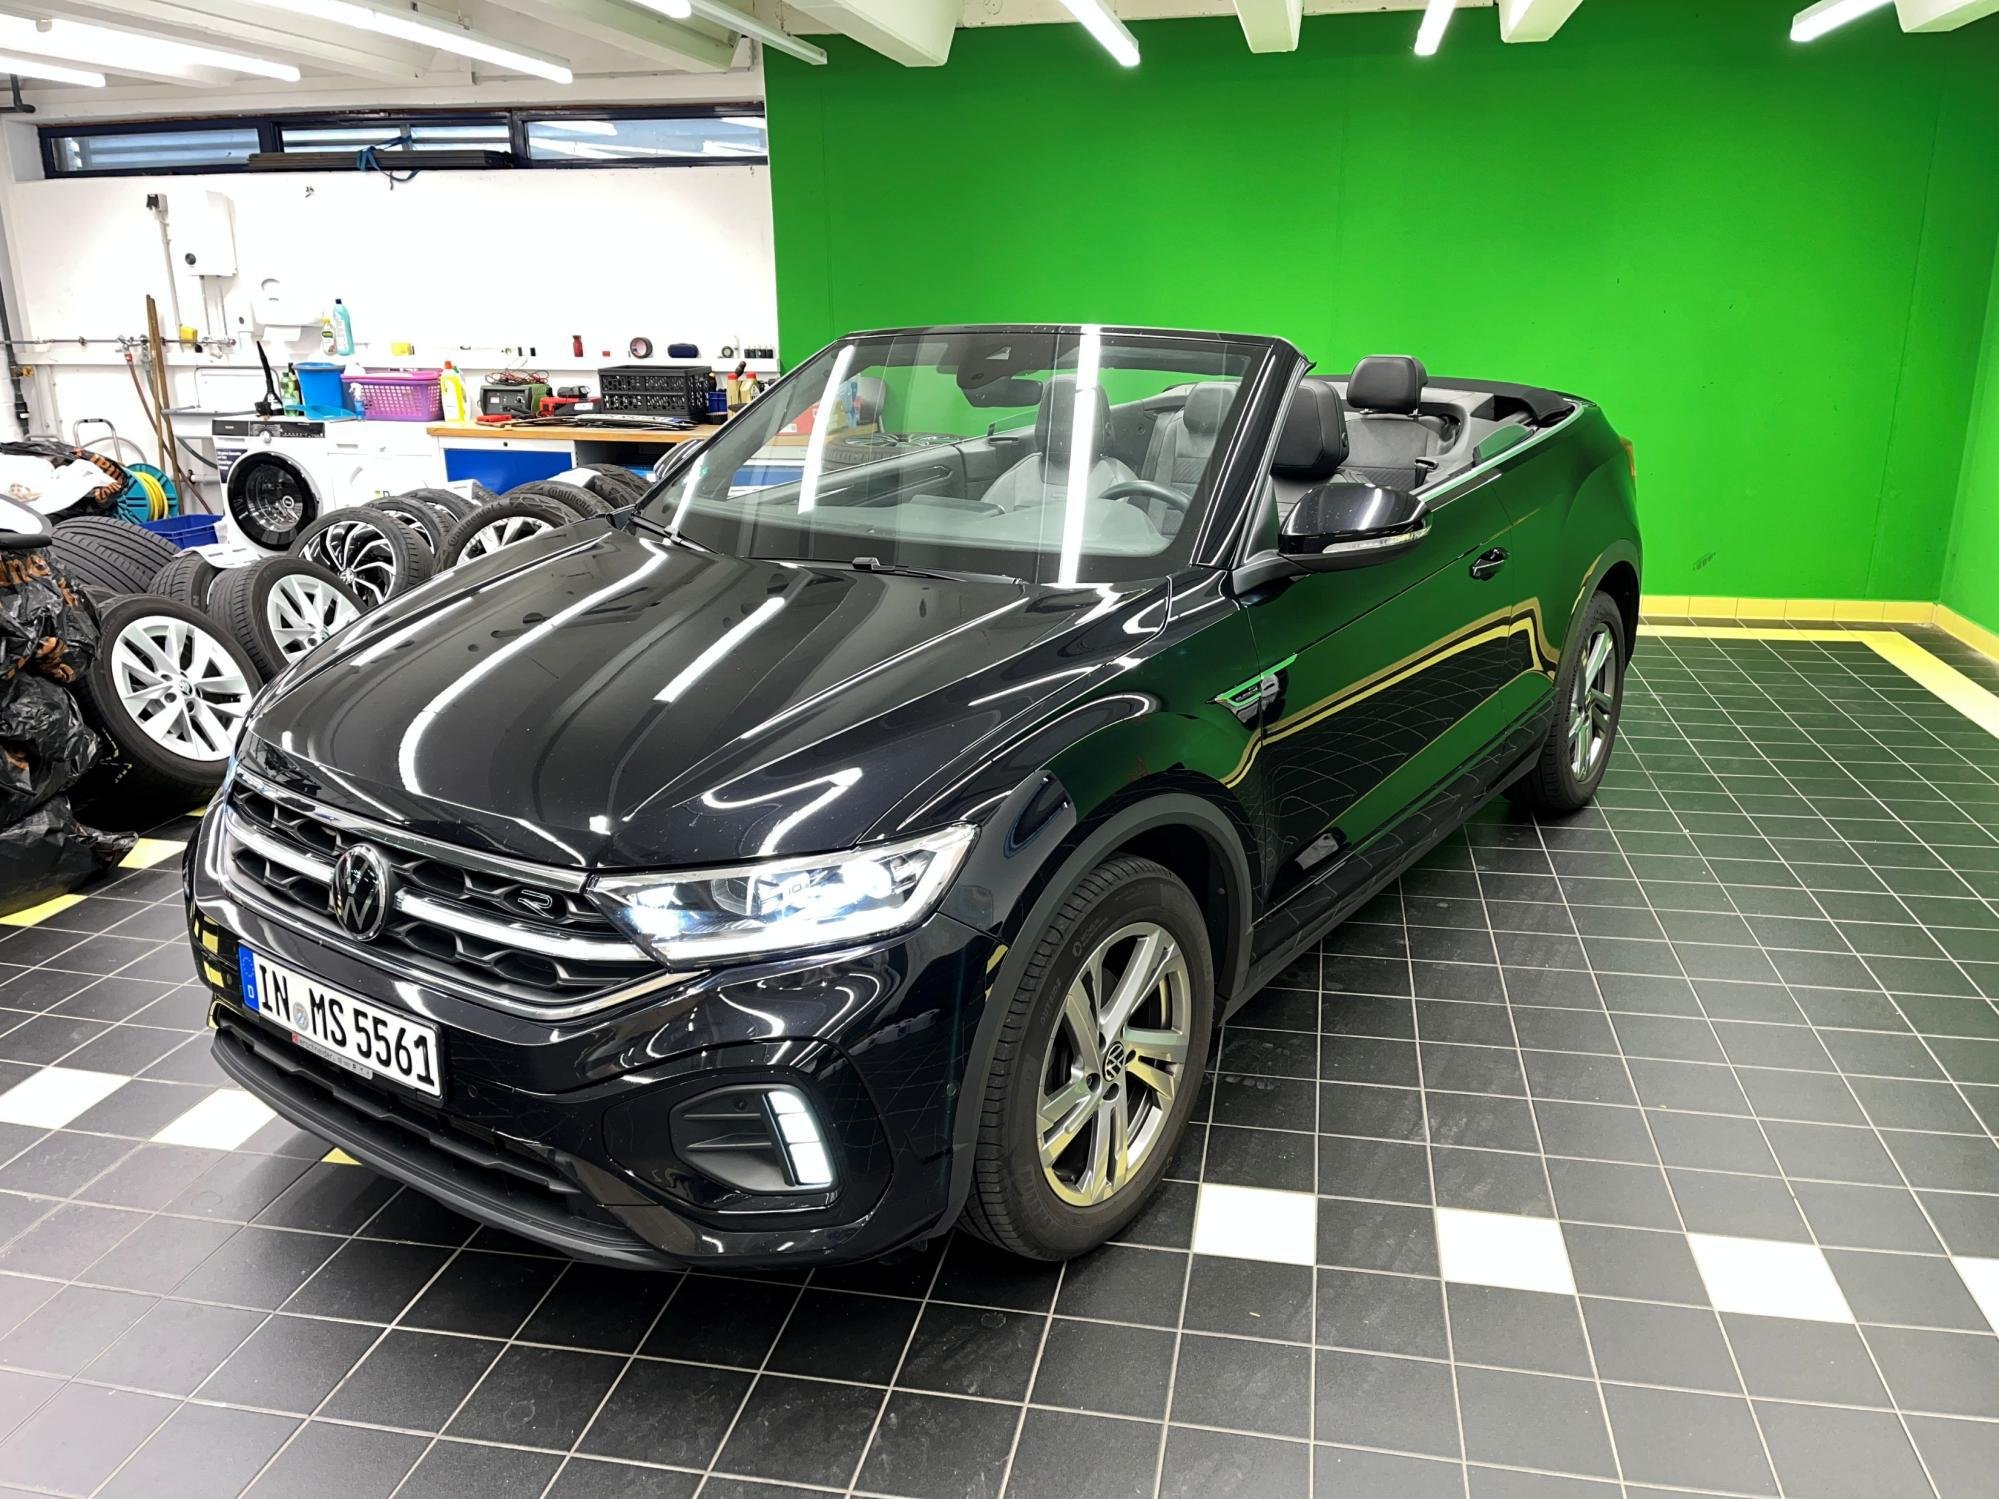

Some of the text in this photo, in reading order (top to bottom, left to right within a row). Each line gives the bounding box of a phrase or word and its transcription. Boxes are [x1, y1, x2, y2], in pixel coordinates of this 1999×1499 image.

[259, 964, 435, 1088] IN MS 5561
